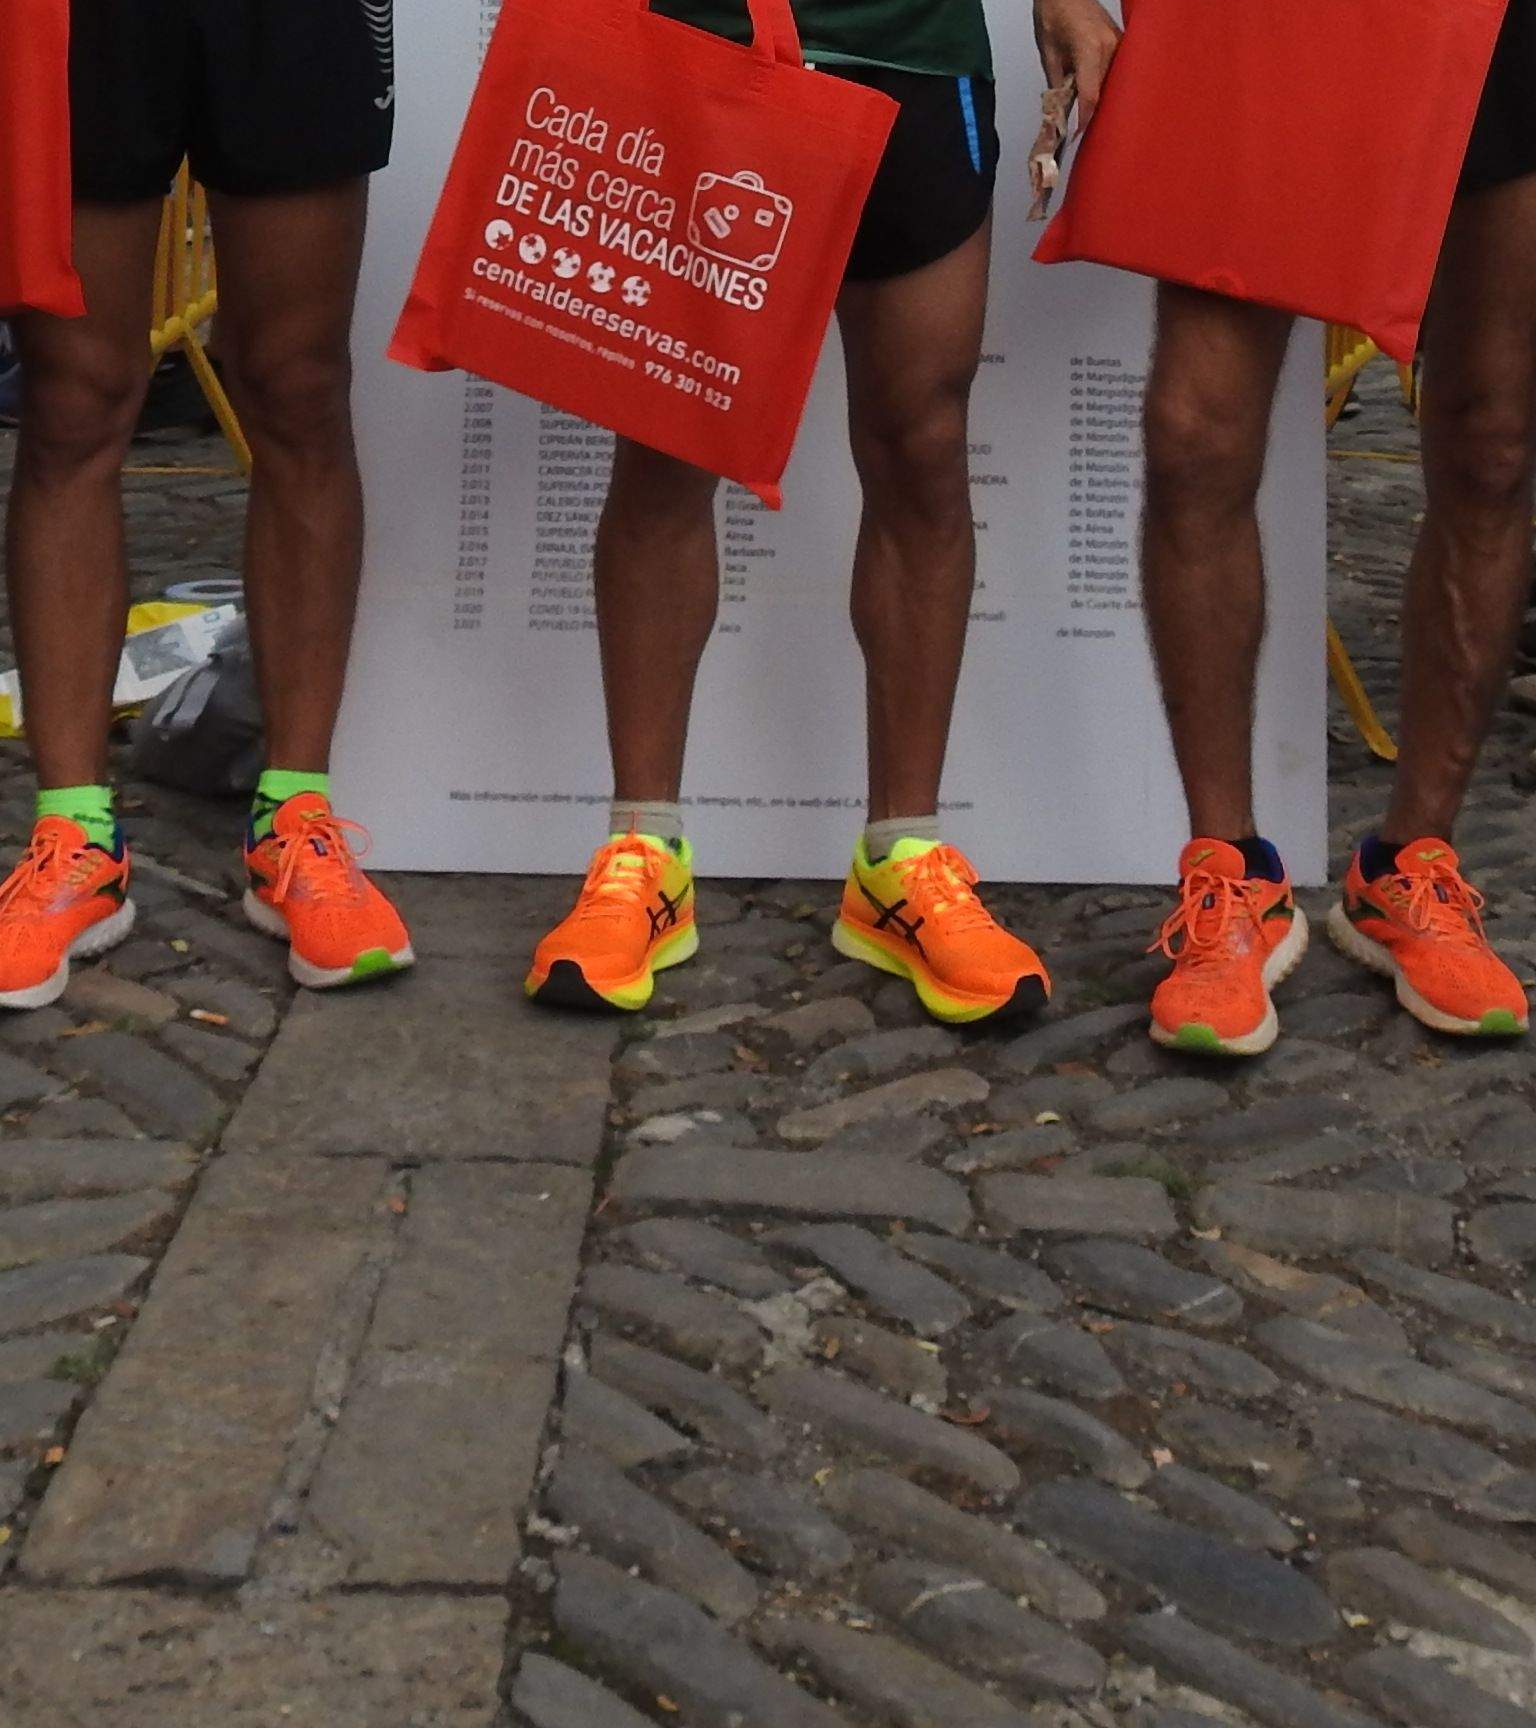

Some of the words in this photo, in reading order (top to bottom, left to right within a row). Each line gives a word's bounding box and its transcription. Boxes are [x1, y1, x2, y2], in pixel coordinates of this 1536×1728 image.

[525, 86, 609, 154] Cada
[615, 127, 666, 176] día
[509, 138, 580, 190] más
[586, 170, 677, 231] cerca
[495, 173, 539, 215] DE
[538, 190, 593, 237] LAS
[599, 213, 768, 310] VACACIONES
[472, 256, 742, 384] centraldereservas.com
[644, 360, 672, 384] 976
